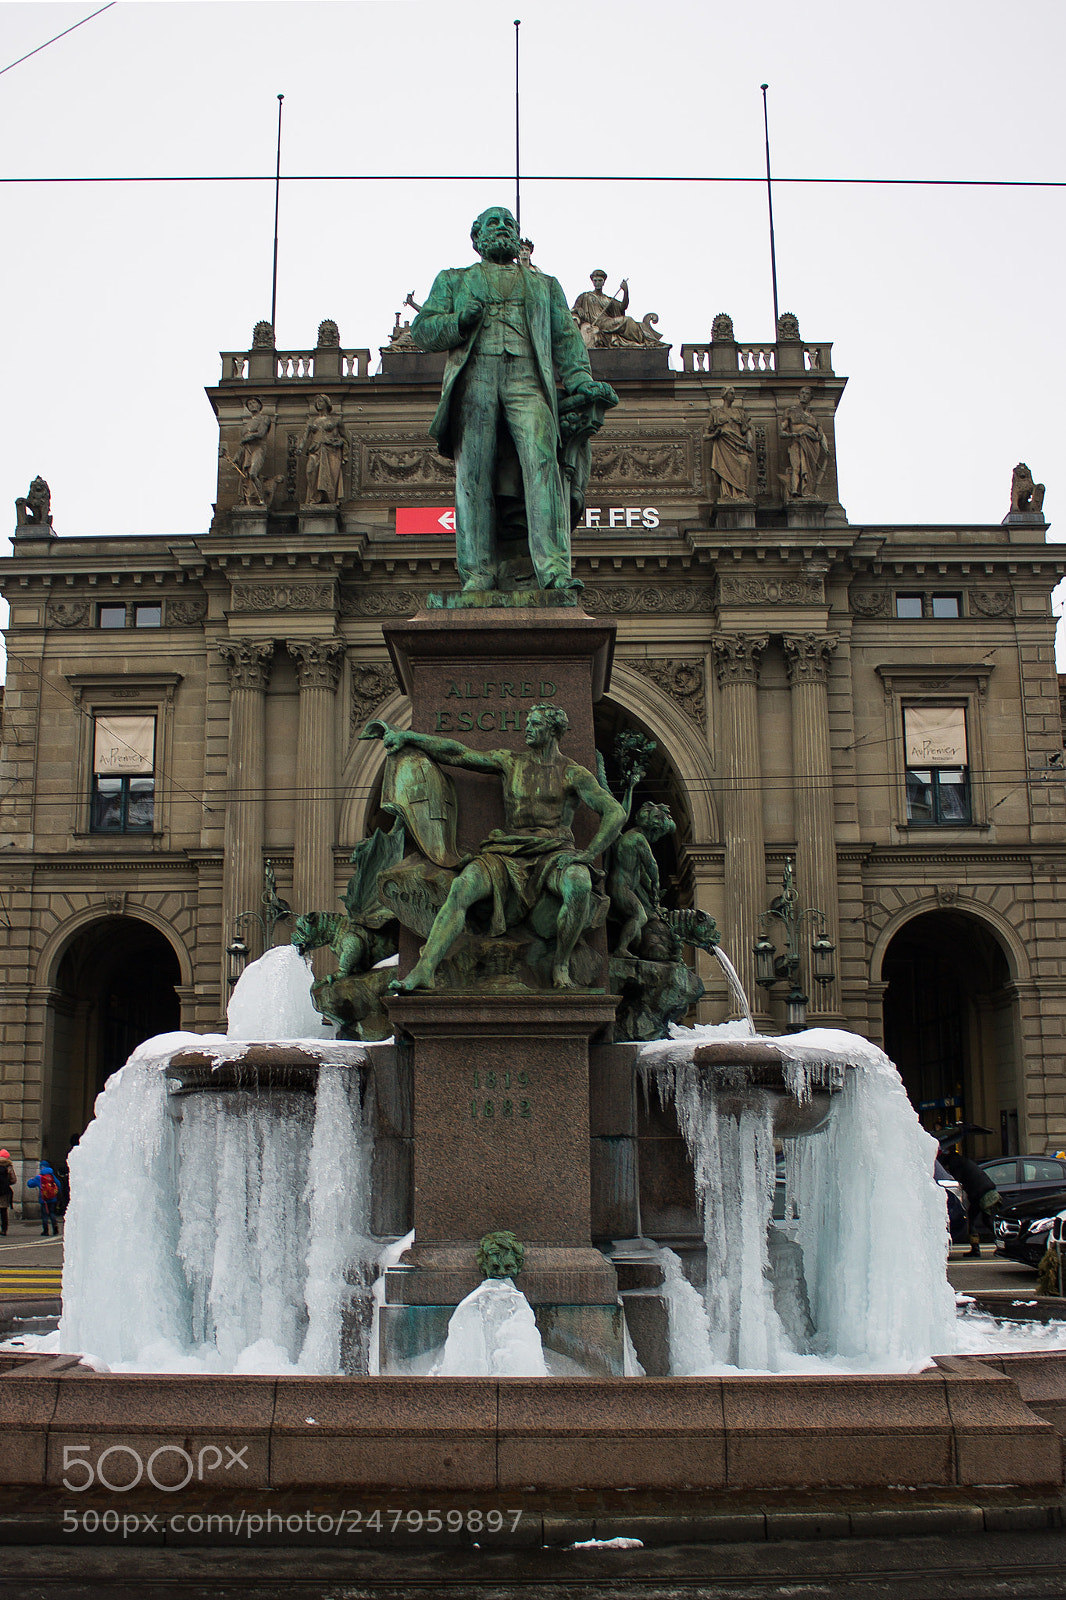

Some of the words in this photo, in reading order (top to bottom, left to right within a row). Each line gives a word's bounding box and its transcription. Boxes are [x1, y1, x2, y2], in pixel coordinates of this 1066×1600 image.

[609, 507, 660, 528] FFS
[445, 681, 557, 698] ALFRED
[473, 1071, 529, 1088] 1819
[470, 1100, 531, 1117] 1882
